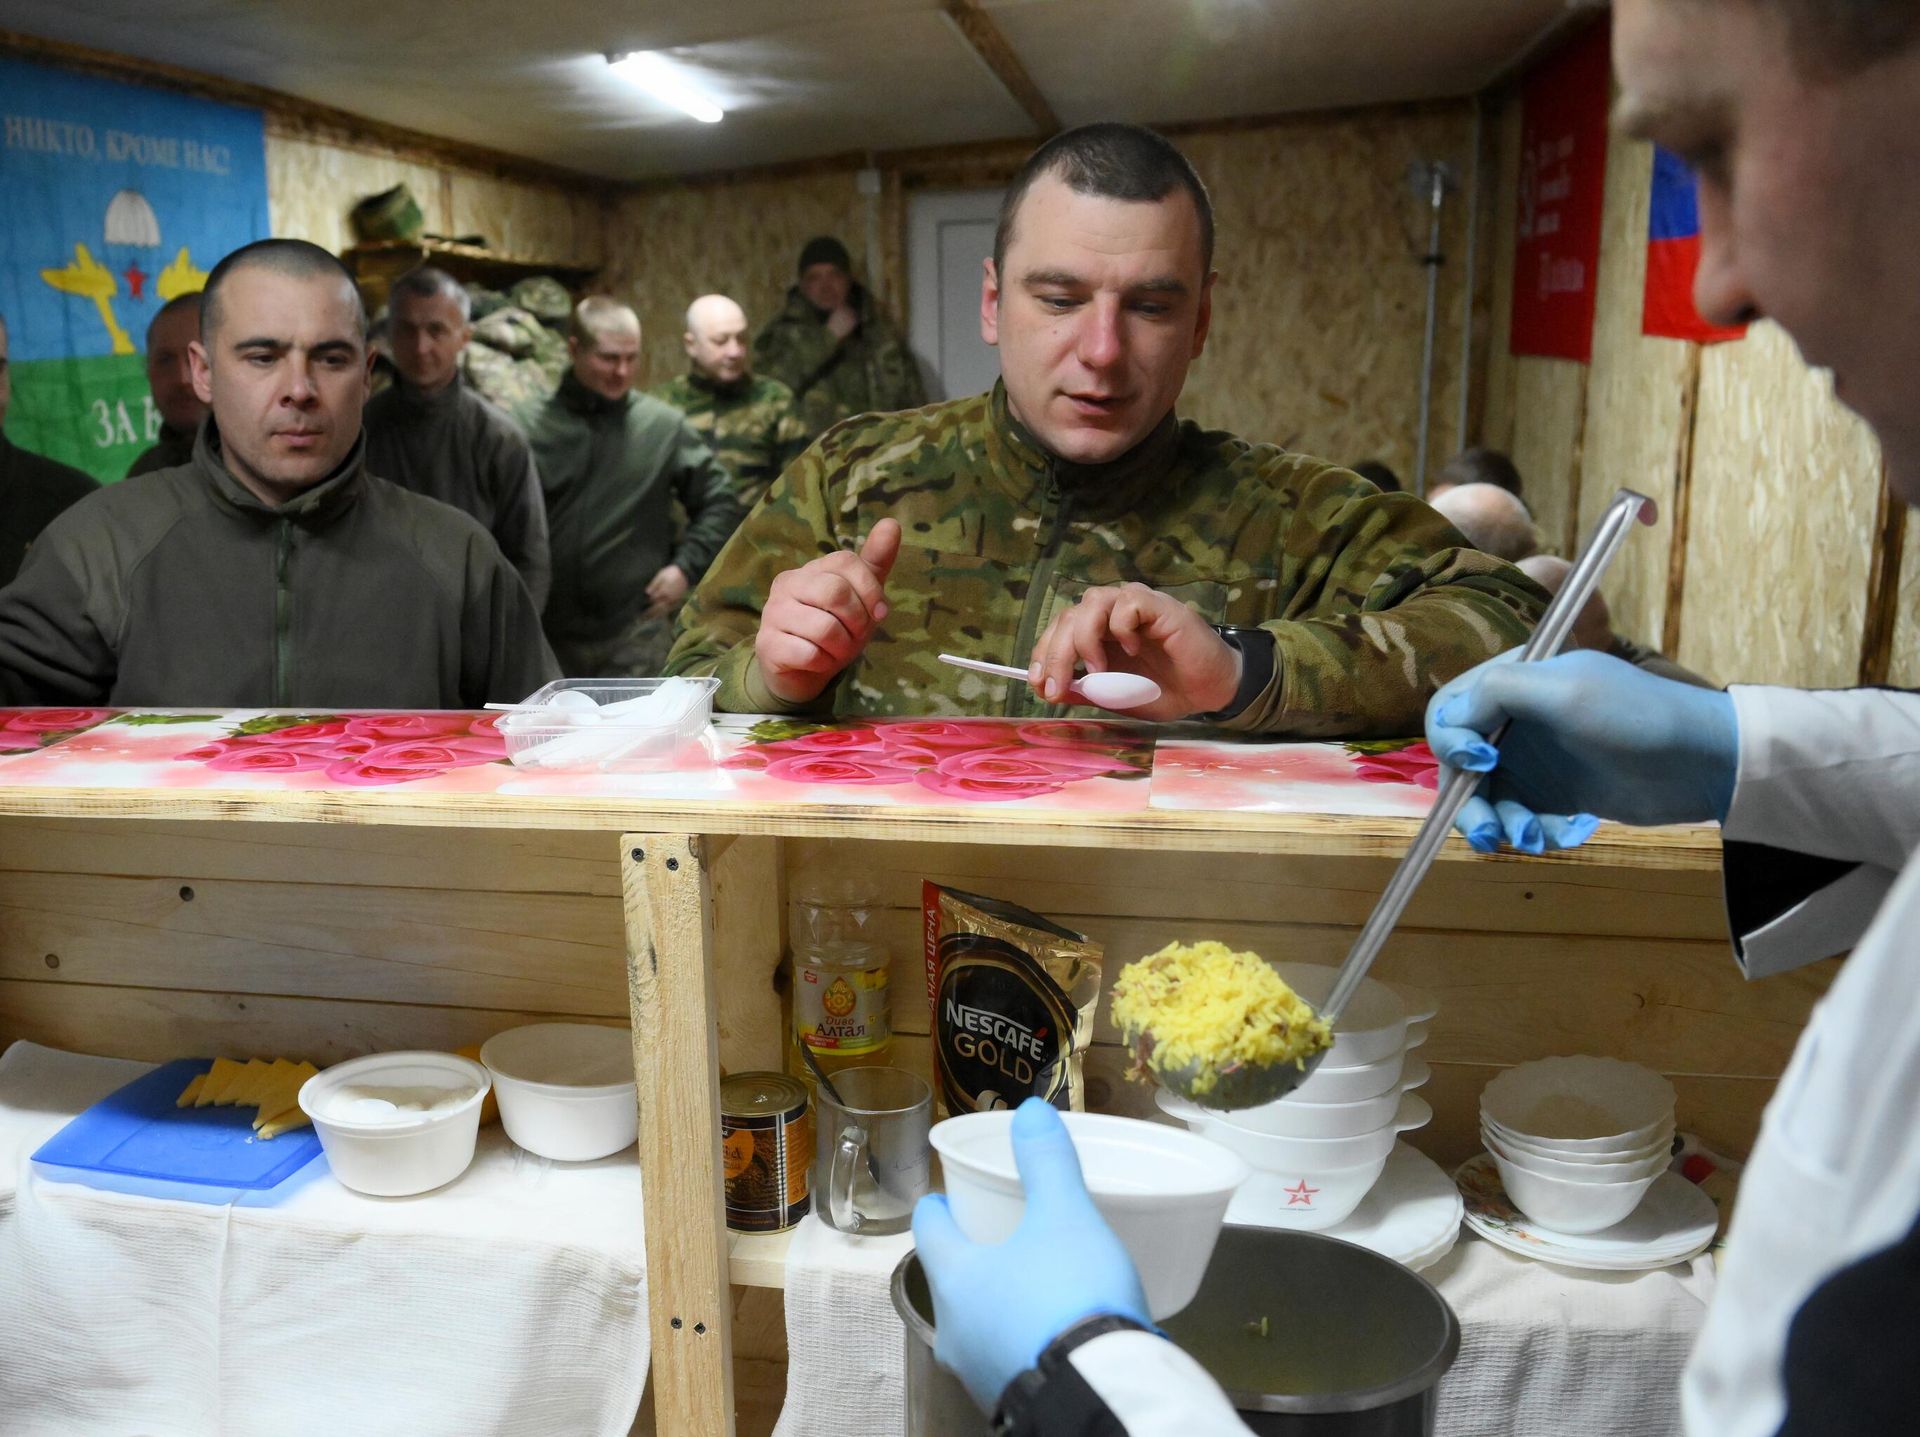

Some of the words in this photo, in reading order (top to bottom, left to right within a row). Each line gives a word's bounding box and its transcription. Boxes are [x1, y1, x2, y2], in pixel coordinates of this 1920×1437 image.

[92, 398, 138, 448] ЗА
[927, 909, 936, 958] ЦЕНА
[953, 1032, 1034, 1085] GOLD
